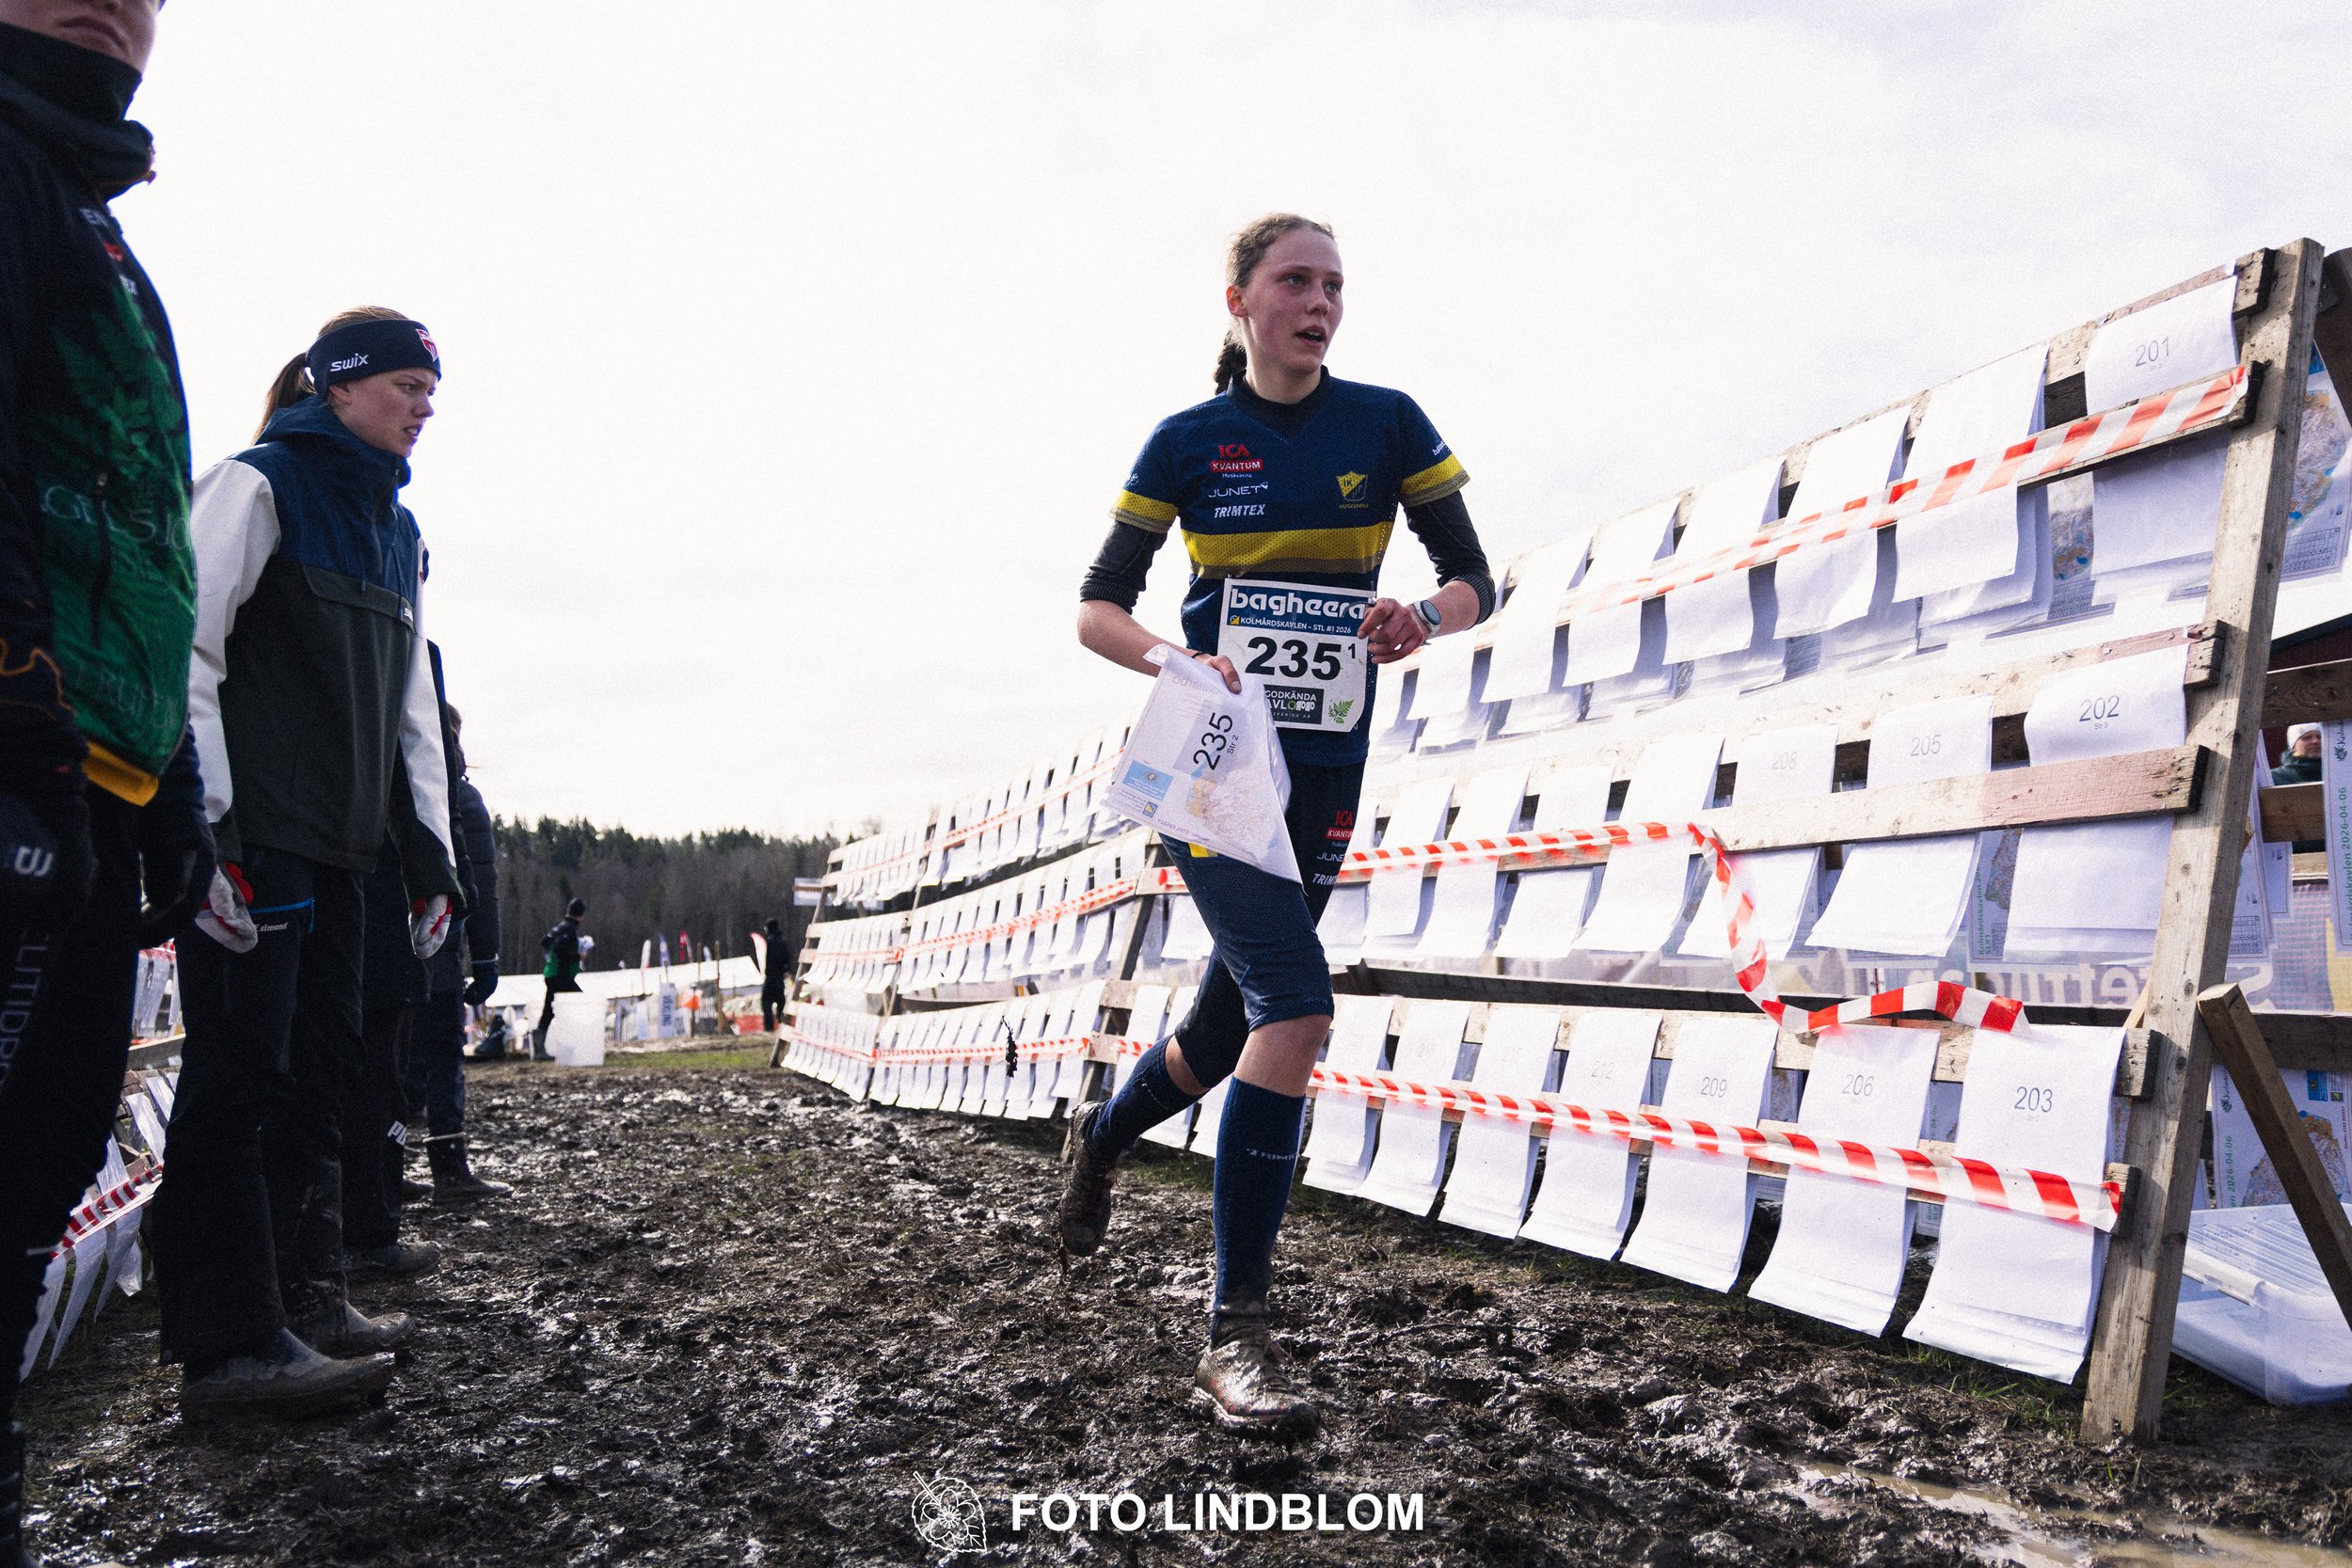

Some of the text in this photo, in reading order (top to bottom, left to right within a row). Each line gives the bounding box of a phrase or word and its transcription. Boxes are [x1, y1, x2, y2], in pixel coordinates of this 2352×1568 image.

[2135, 337, 2169, 367] 201
[1218, 443, 1250, 459] ICA
[1213, 461, 1261, 470] KVANTUM
[1207, 485, 1262, 498] JUNET
[1214, 503, 1266, 518] TRIMTEX
[1231, 588, 1365, 619] bagheera
[1240, 616, 1307, 630] KOLMÅRDSKAVLEN
[1245, 636, 1356, 681] 235 1
[1265, 689, 1317, 702] GODKÄNDA
[2079, 695, 2120, 722] 202
[1192, 712, 1233, 771] 235
[1227, 743, 1236, 754] Str
[1910, 734, 1942, 756] 205
[1771, 751, 1798, 770] 208
[2338, 786, 2351, 850] 2026-04-06
[1700, 1076, 1727, 1098] 209
[1841, 1073, 1874, 1097] 206
[2013, 1086, 2053, 1113] 203
[2225, 1135, 2236, 1193] 2026-04-06
